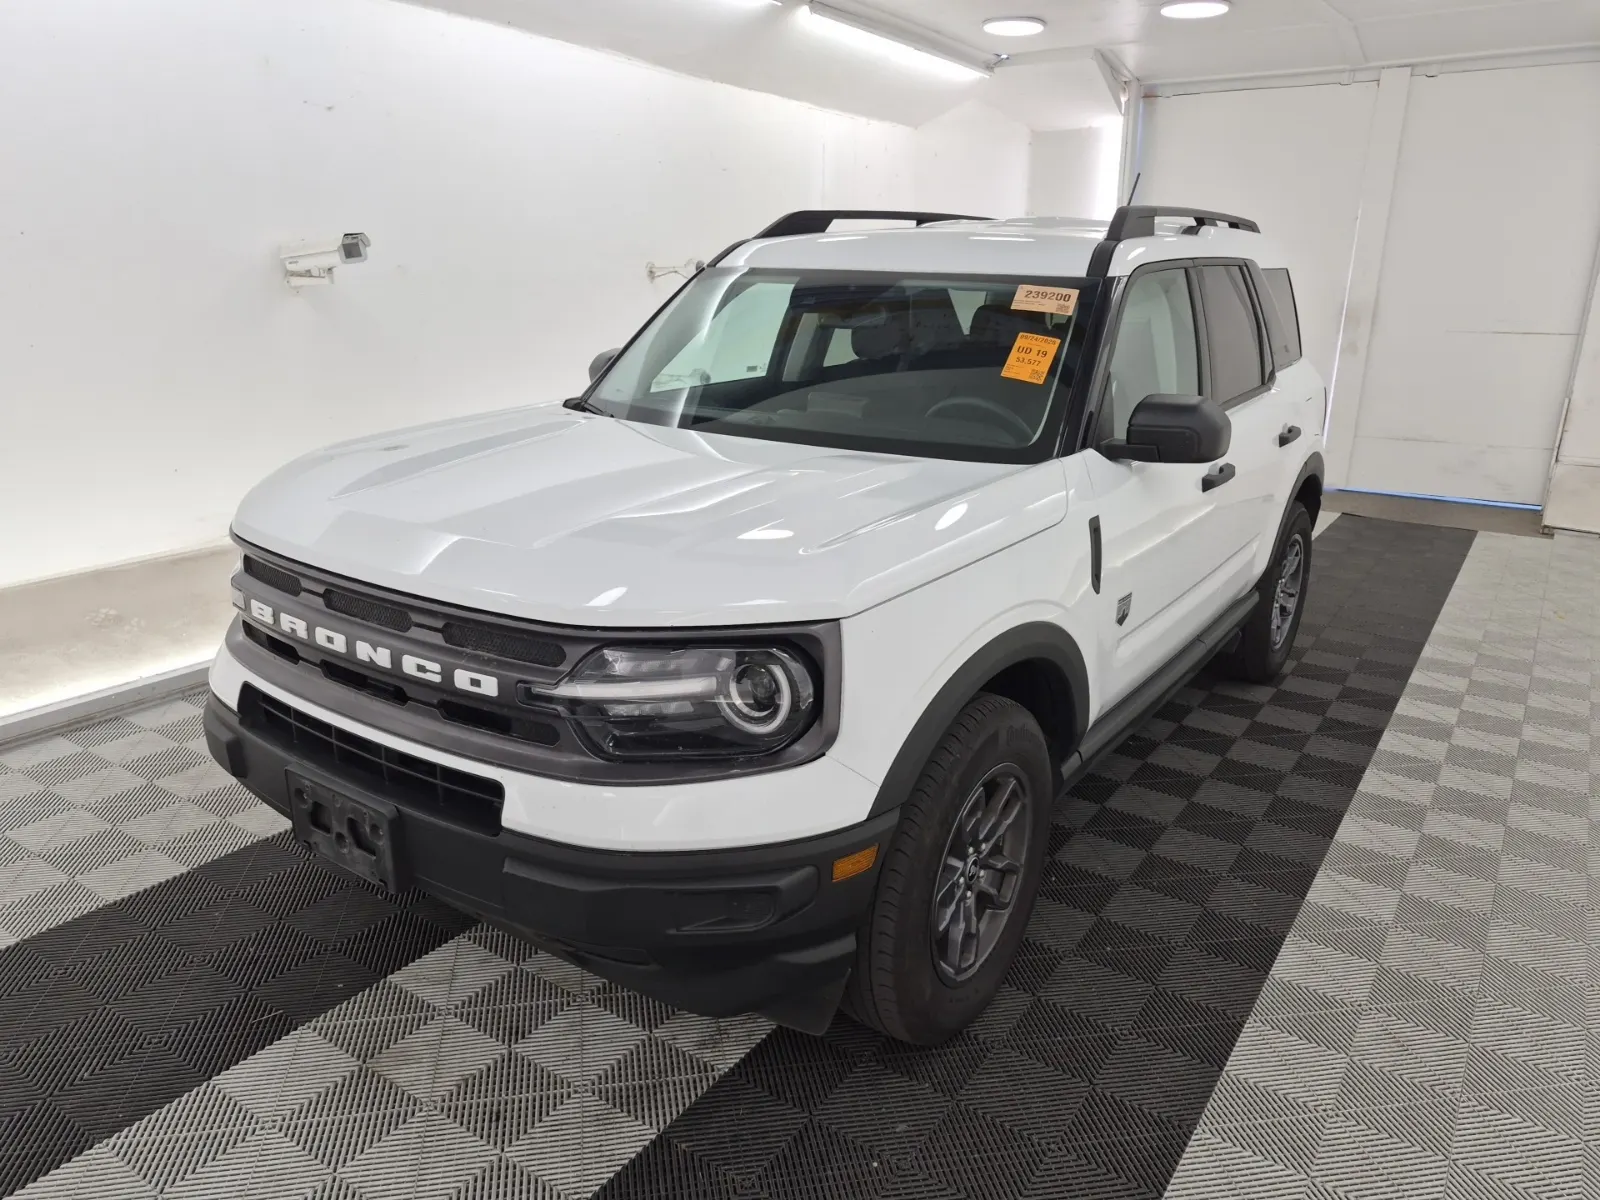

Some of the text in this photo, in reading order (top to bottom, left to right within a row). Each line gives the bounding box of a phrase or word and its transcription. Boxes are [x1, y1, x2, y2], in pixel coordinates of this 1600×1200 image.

[1024, 290, 1071, 302] 239200
[1017, 345, 1032, 355] UD
[1036, 349, 1048, 358] 19
[250, 598, 499, 697] BRONCO
